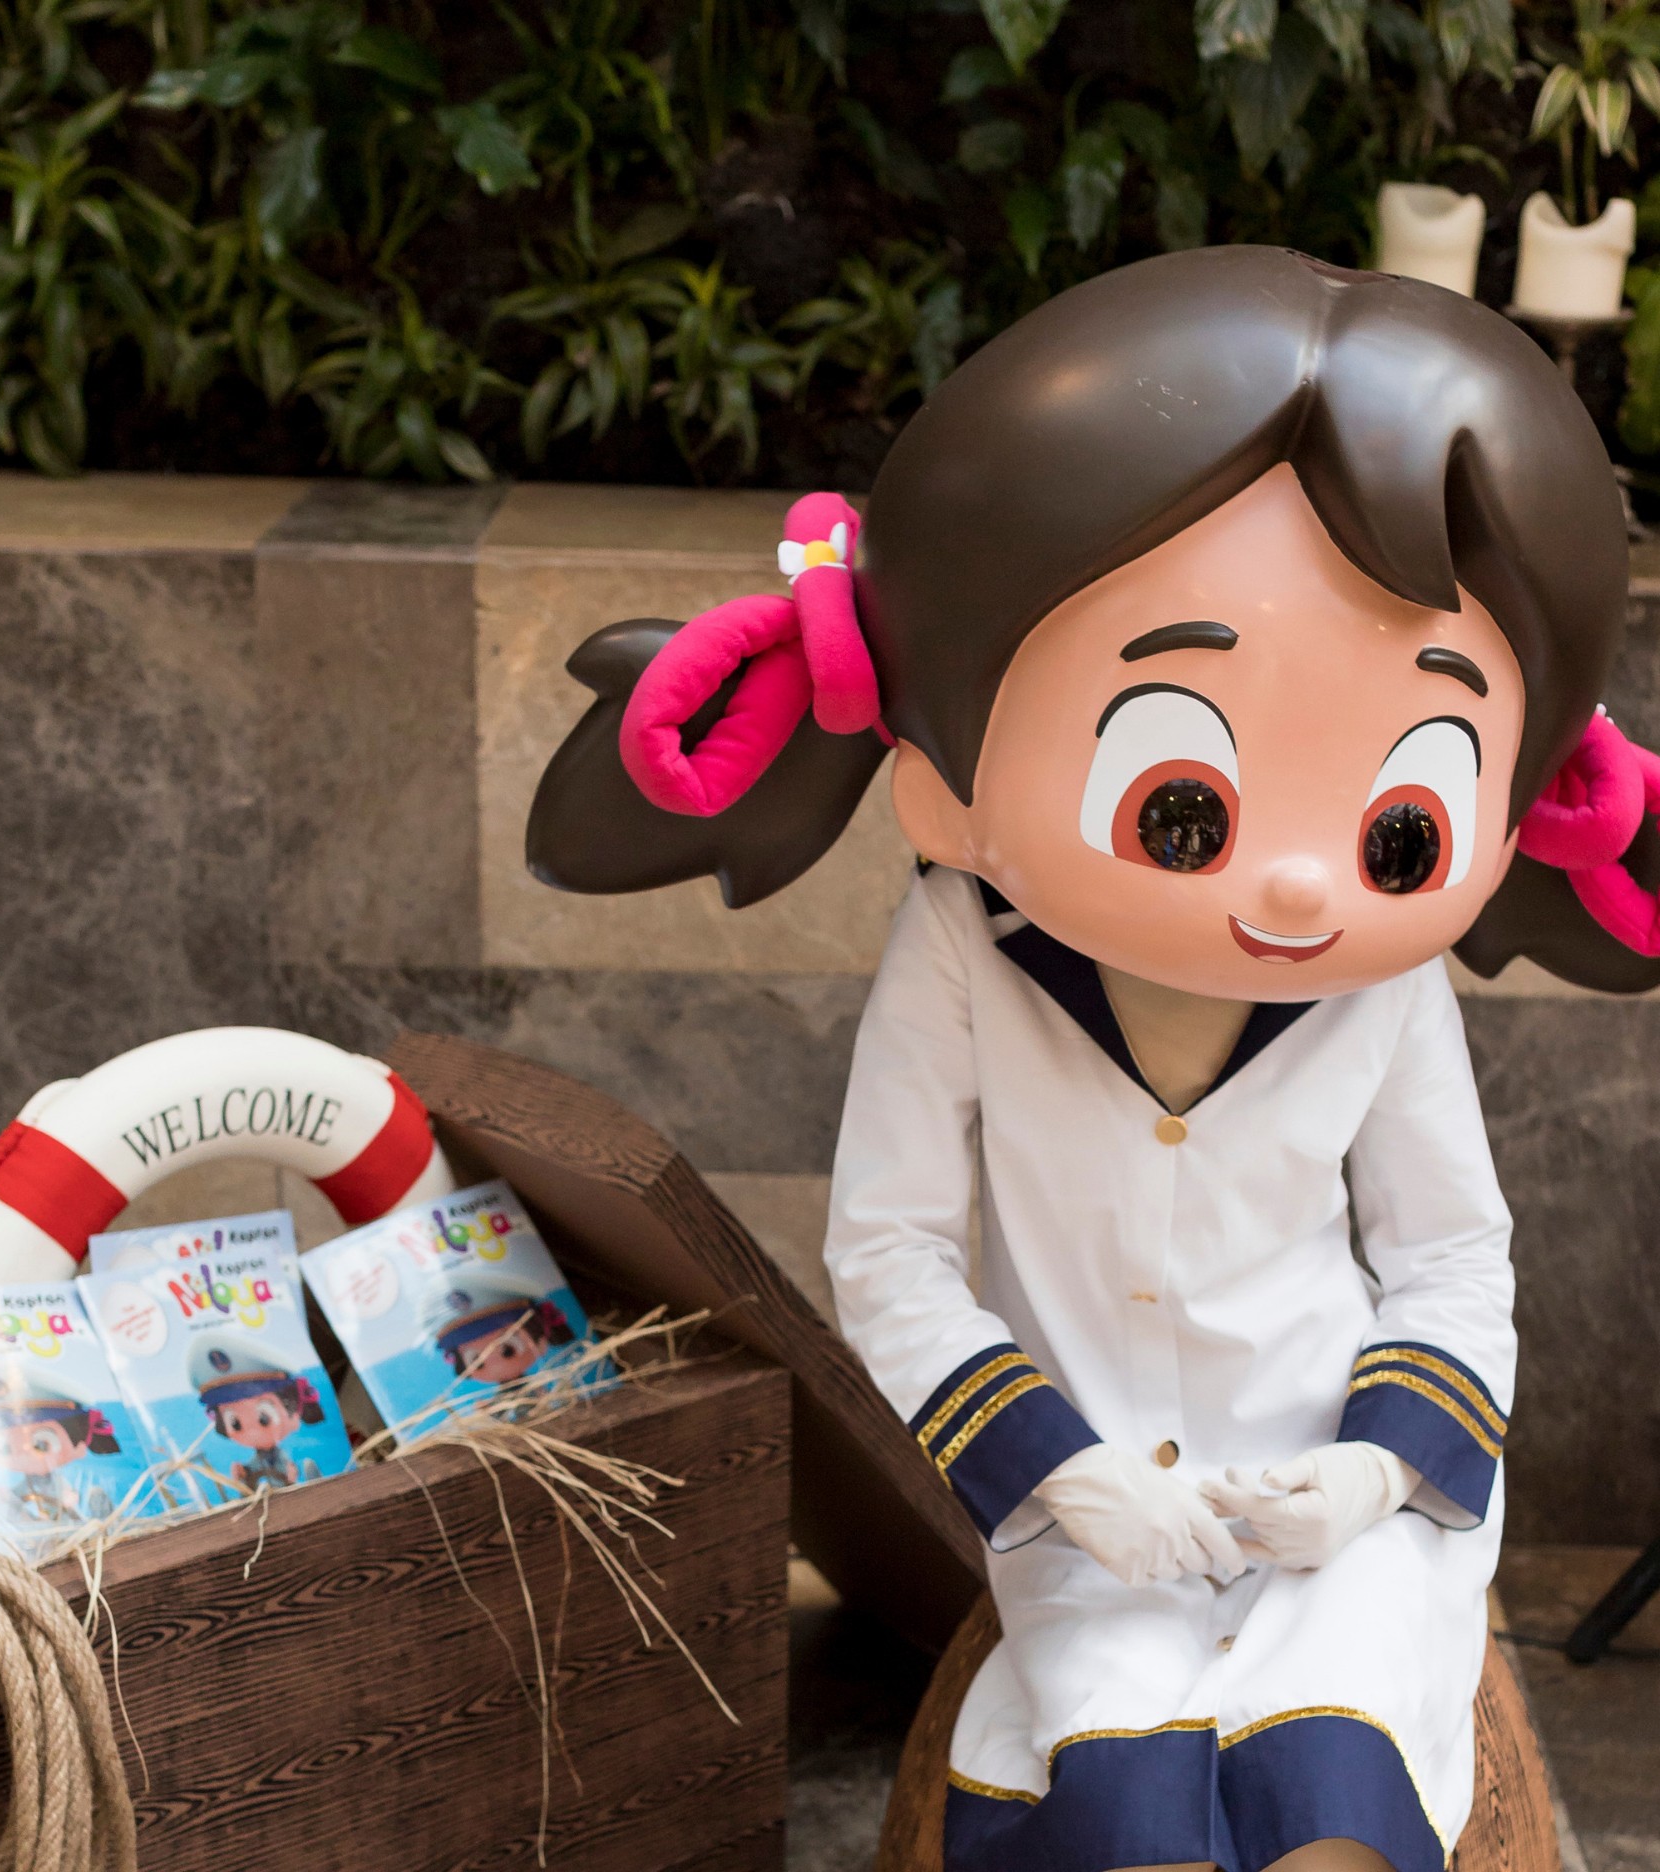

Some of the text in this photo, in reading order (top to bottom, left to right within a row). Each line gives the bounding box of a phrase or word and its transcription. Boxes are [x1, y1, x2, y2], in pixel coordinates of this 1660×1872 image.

[121, 1087, 343, 1167] WELCOME
[229, 1226, 280, 1243] Kaptan
[216, 1258, 266, 1275] Kaptan
[3, 1293, 66, 1309] Kaptan
